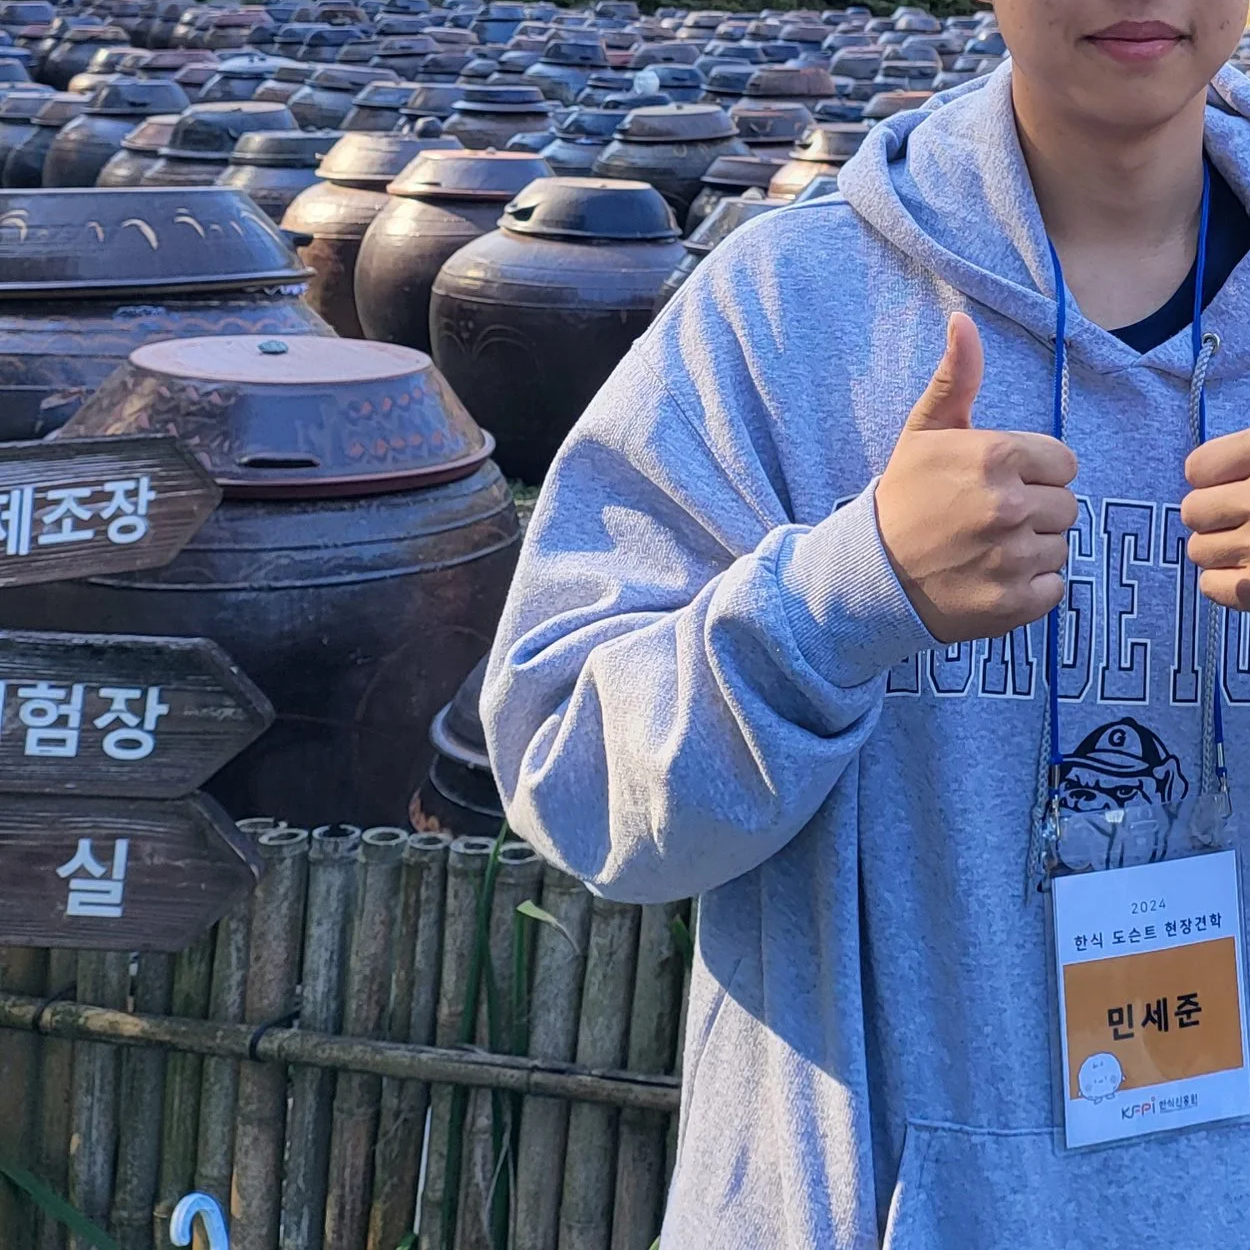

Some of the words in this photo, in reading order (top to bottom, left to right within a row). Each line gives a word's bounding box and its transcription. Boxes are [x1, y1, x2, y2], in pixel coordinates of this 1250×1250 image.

[0, 680, 169, 761] 험장
[1107, 728, 1127, 748] G
[55, 838, 130, 918] 실
[1131, 898, 1166, 915] 2024
[1074, 931, 1104, 952] 한식
[1112, 925, 1157, 945] 도슨트
[1164, 912, 1222, 937] 현장견학
[1107, 992, 1202, 1041] 민세준
